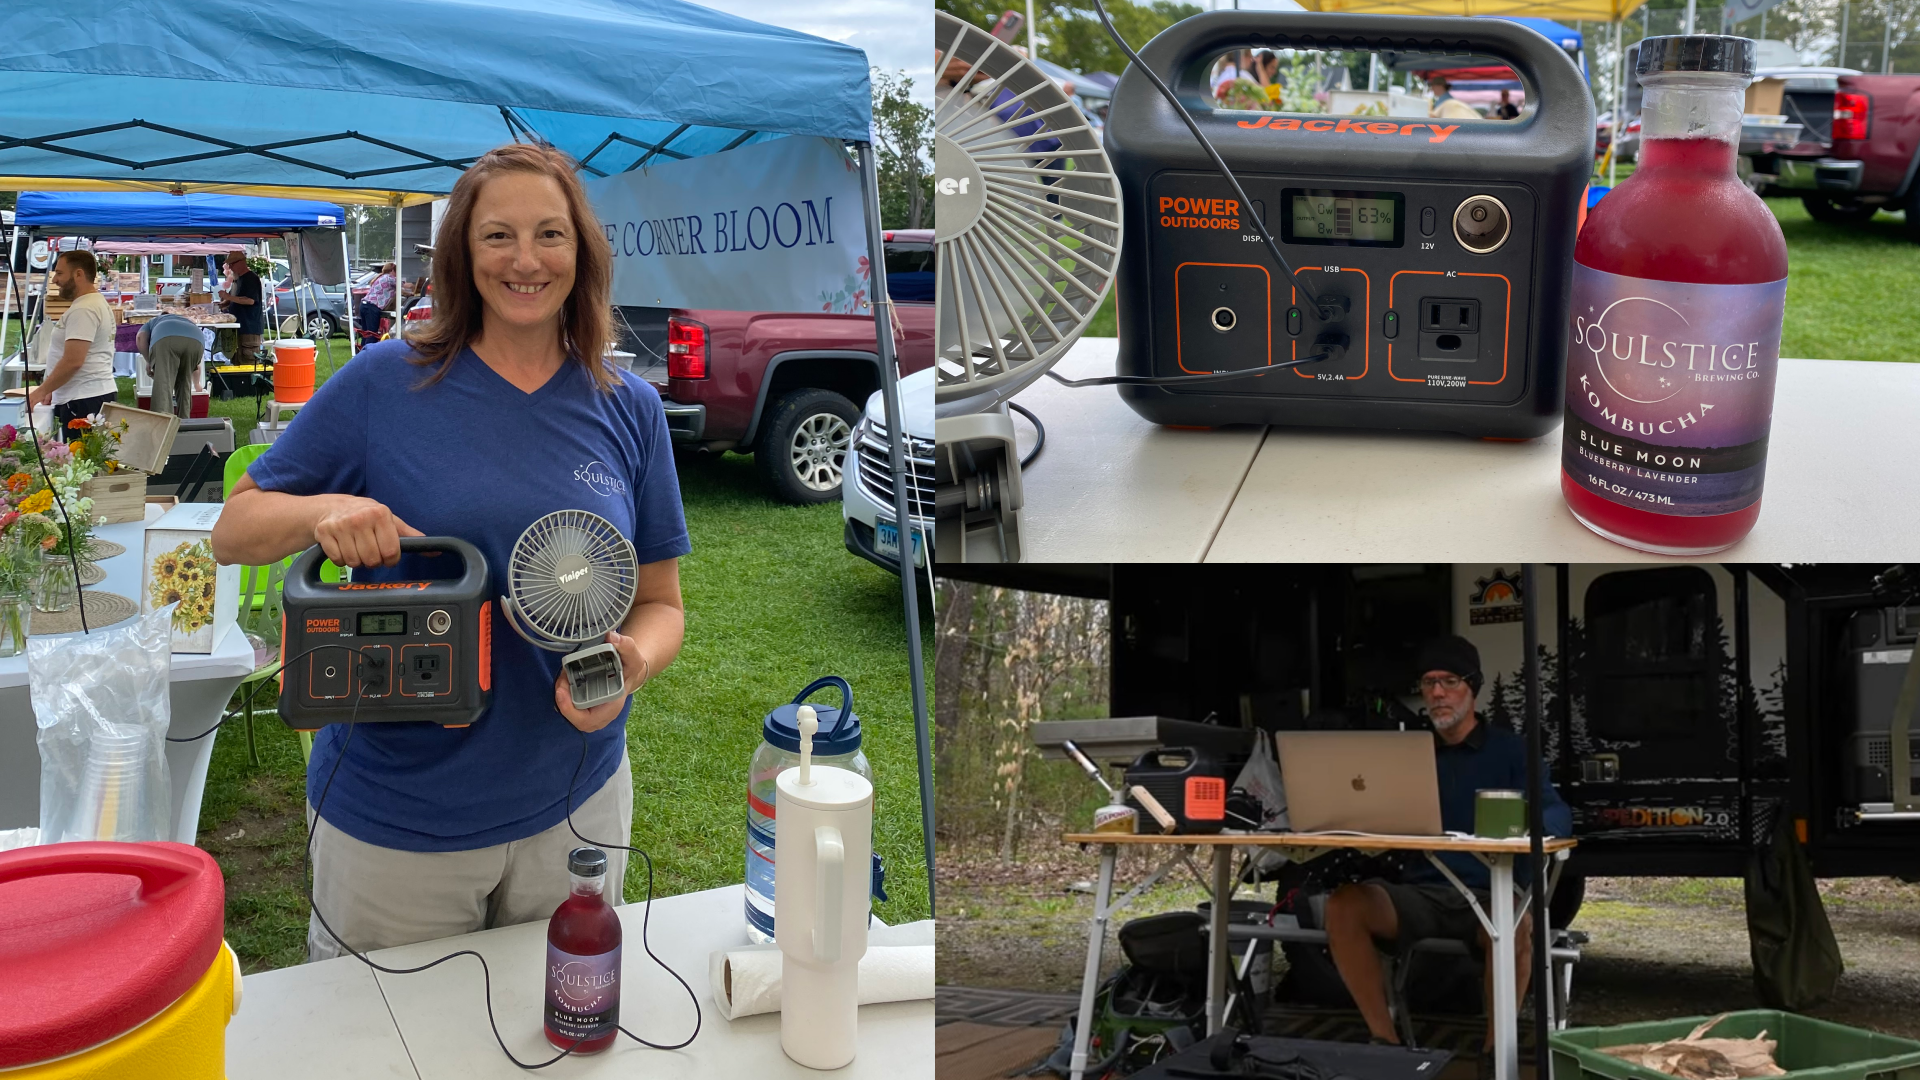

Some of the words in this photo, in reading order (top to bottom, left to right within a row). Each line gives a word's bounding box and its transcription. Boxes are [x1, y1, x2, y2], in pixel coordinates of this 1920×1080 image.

[1237, 116, 1460, 143] Jackery
[935, 177, 970, 196] er
[1159, 197, 1240, 216] POWER
[1358, 207, 1392, 223] 63%
[623, 215, 707, 257] CORNER
[714, 196, 835, 253] BLOOM
[1160, 215, 1240, 231] OUTDOORS
[1420, 242, 1435, 250] 12V
[1324, 265, 1340, 273] USB
[1446, 270, 1457, 278] AC
[1575, 316, 1759, 371] SOULSTICE
[1317, 373, 1345, 382] 5V,2.4A
[1427, 379, 1467, 388] 110V,200W
[1694, 373, 1743, 382] BREWING
[1579, 373, 1716, 436] KOMBUCHA
[1580, 430, 1623, 456] BLUE
[1636, 451, 1701, 469] MOON
[1579, 446, 1631, 474] BLUEBERRY
[1637, 464, 1698, 484] LAVENDER
[1588, 473, 1598, 485] 16
[1598, 478, 1611, 491] FL
[1611, 483, 1628, 497] OZ
[1634, 490, 1655, 503] 473
[1657, 494, 1675, 506] ML
[558, 566, 588, 585] Viniper
[338, 581, 432, 591] Jackery
[306, 618, 340, 627] POWER
[1703, 813, 1729, 826] 2.0
[552, 966, 615, 987] SOULSTICE
[554, 989, 602, 1013] KOMBUCHA
[555, 1011, 573, 1021] BLUE
